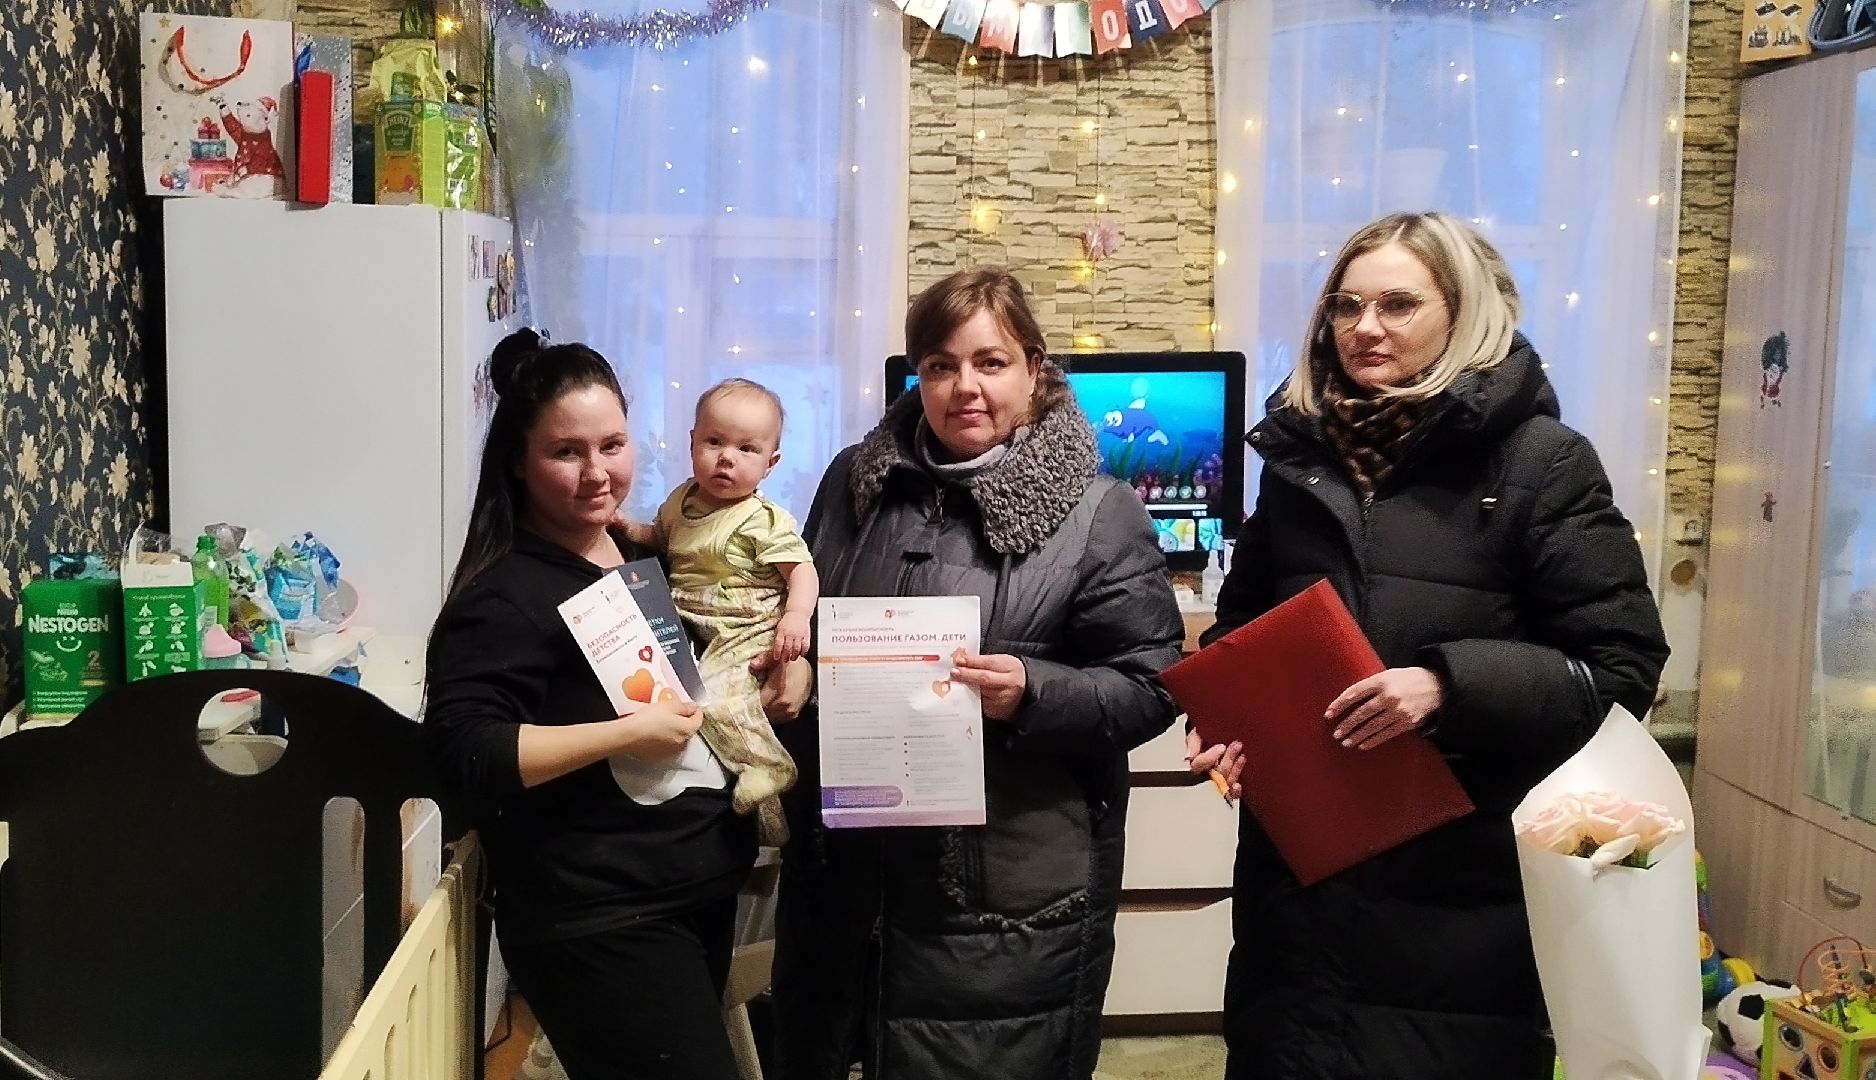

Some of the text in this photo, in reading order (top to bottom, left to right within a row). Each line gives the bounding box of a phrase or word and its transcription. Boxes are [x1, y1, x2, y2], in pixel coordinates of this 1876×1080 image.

[28, 614, 109, 634] NESTOGEN
[587, 614, 638, 649] БЕЗОПАСНОСТЬ
[592, 635, 621, 658] ДЕТСТВА
[831, 634, 901, 644] ПОЛЬЗОВАНИЕ
[941, 633, 967, 642] ДЕТИ
[87, 650, 101, 667] 2
